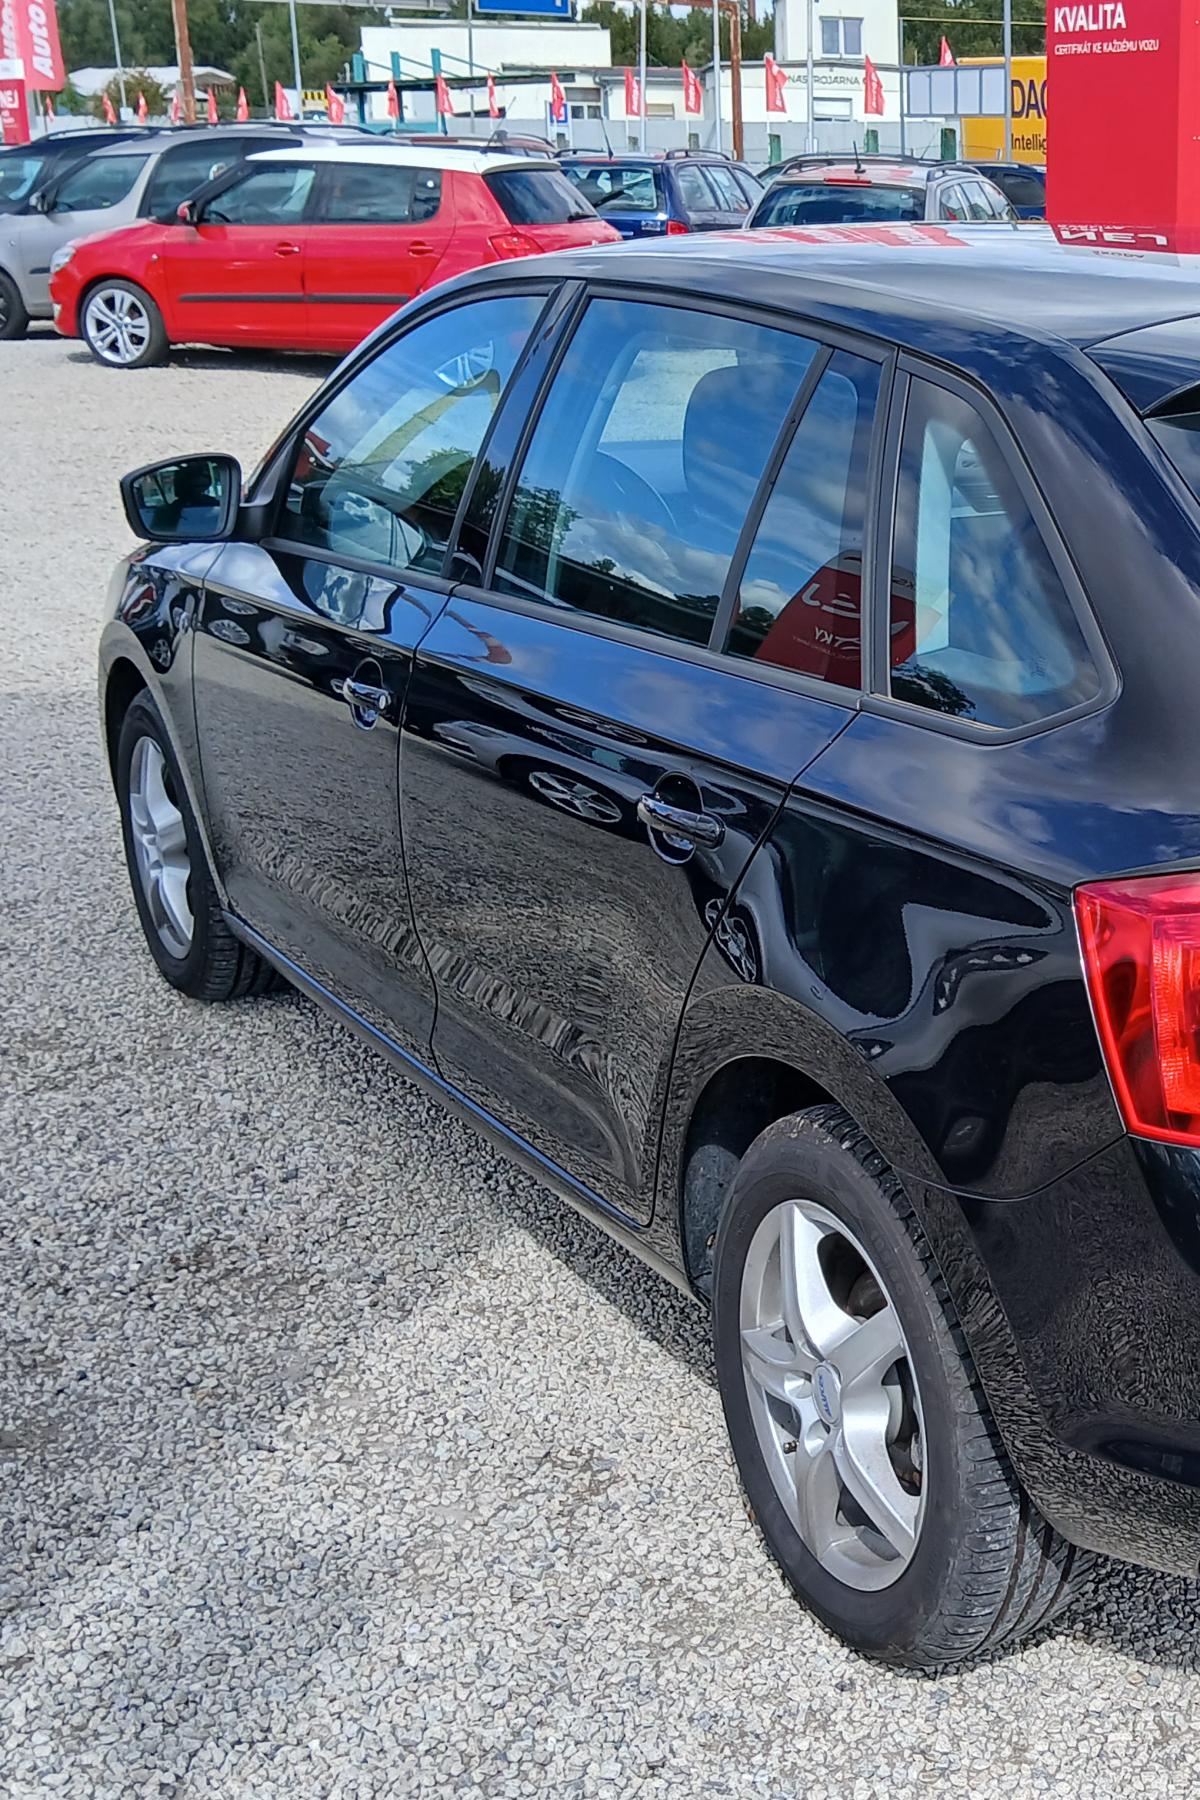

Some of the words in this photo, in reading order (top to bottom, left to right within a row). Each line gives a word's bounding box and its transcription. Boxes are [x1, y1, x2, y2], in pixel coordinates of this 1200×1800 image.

[1054, 3, 1127, 33] KVALITA
[28, 3, 55, 80] Auto
[1054, 40, 1091, 55] CERTIFIKÁT
[1092, 42, 1102, 53] KE
[1138, 39, 1160, 51] VOZU
